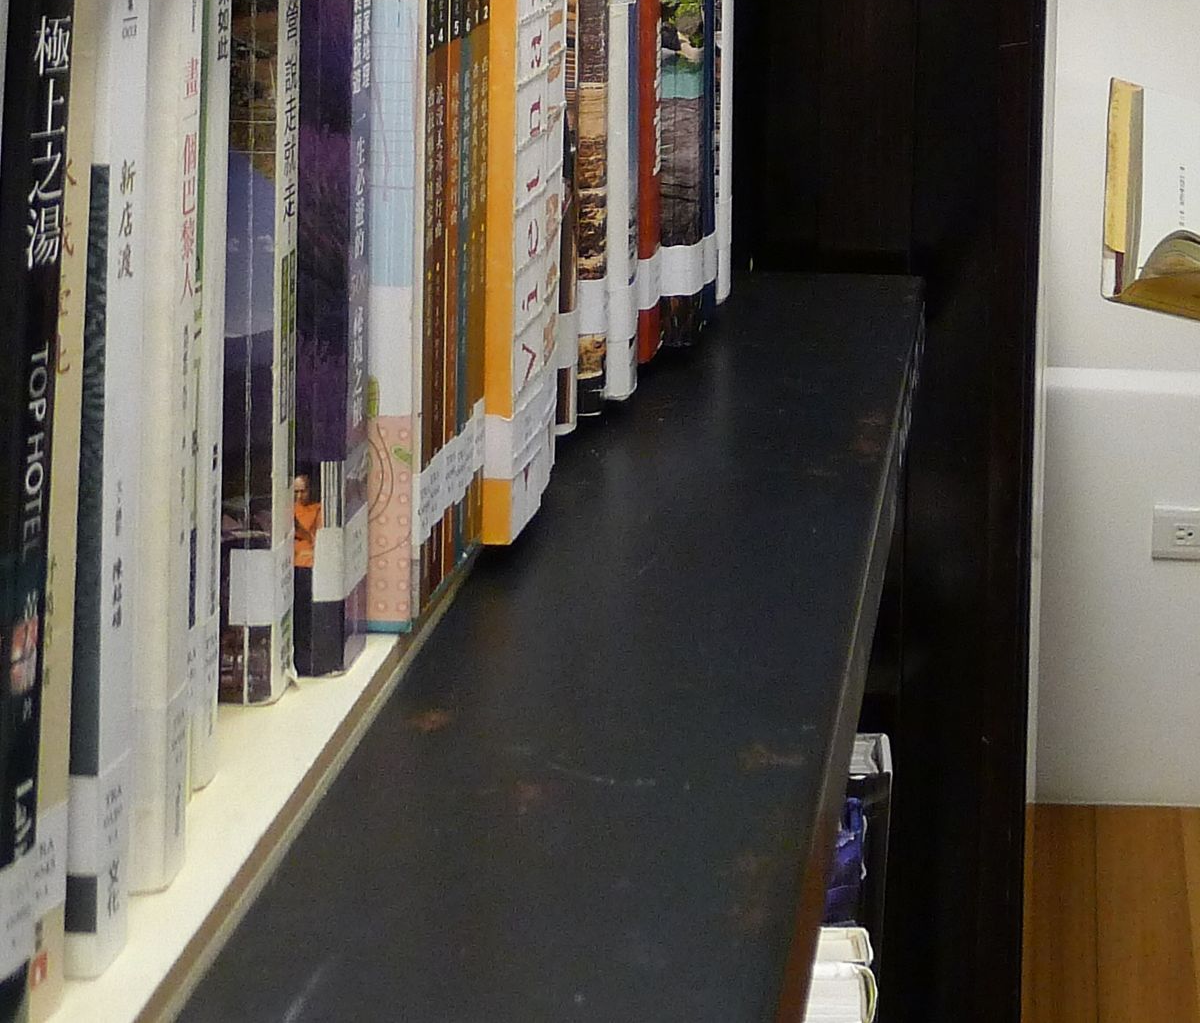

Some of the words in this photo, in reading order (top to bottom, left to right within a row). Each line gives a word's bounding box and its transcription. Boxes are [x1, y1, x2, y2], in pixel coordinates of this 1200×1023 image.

[27, 15, 71, 270] 極上之湯
[118, 159, 136, 279] 新店渡
[28, 340, 49, 422] TOP
[22, 431, 45, 563] HOTEL
